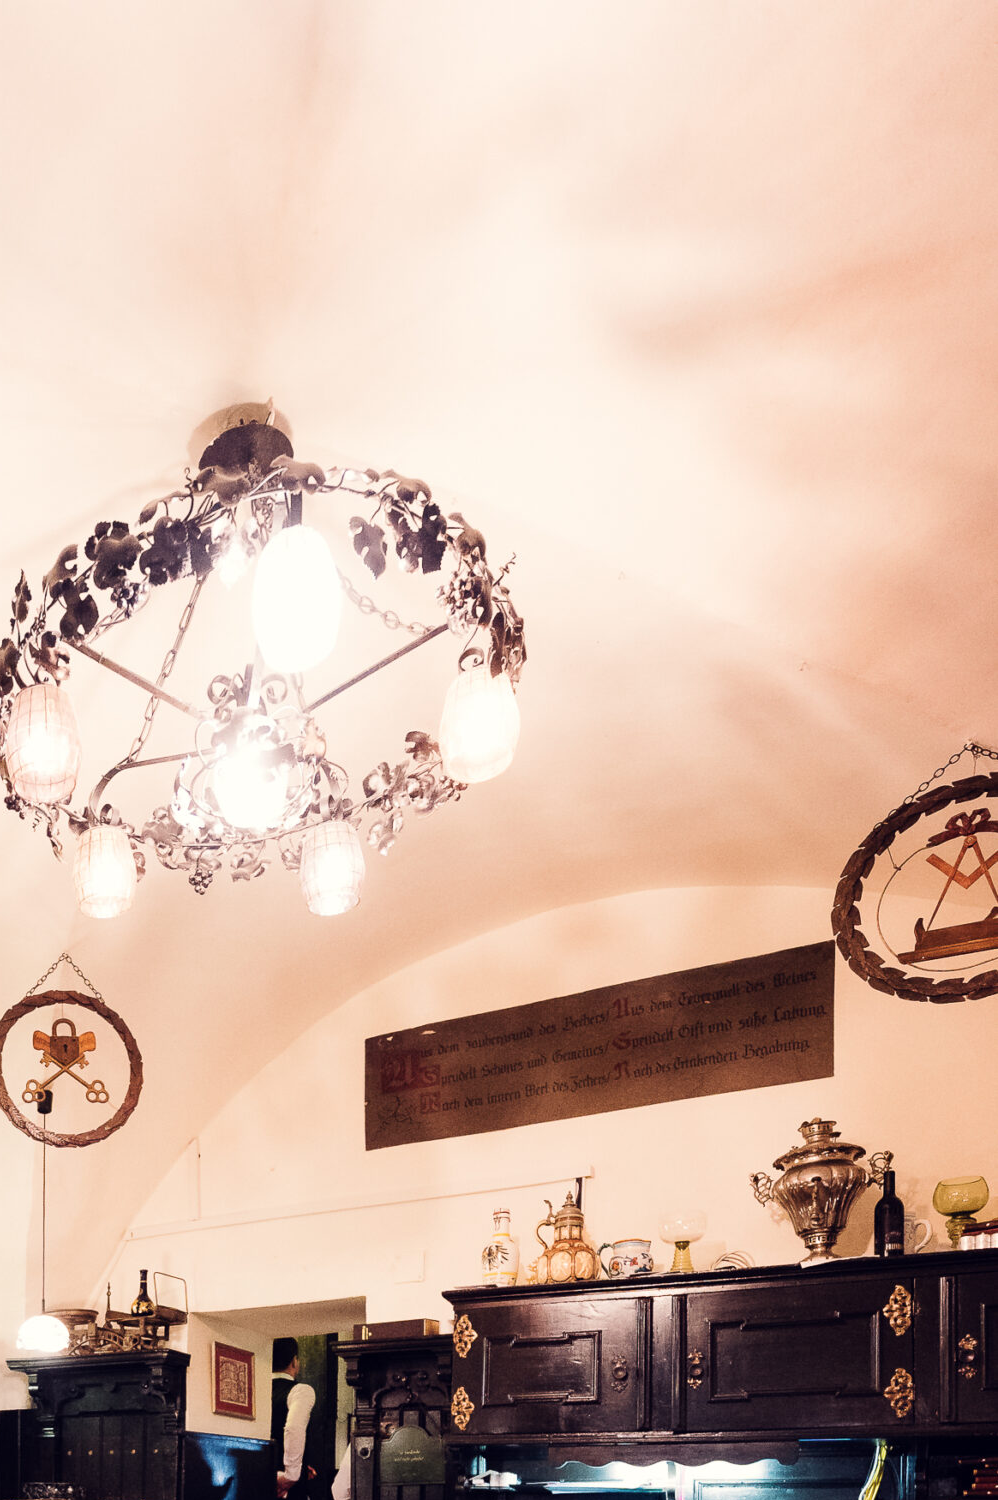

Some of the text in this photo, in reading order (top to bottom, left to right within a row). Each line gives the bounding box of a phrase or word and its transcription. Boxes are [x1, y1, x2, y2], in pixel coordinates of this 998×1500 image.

[438, 1043, 459, 1056] dem
[745, 981, 766, 995] des
[465, 1095, 482, 1107] dem
[553, 1080, 569, 1093] des
[656, 1061, 671, 1074] des
[528, 1055, 547, 1070] und
